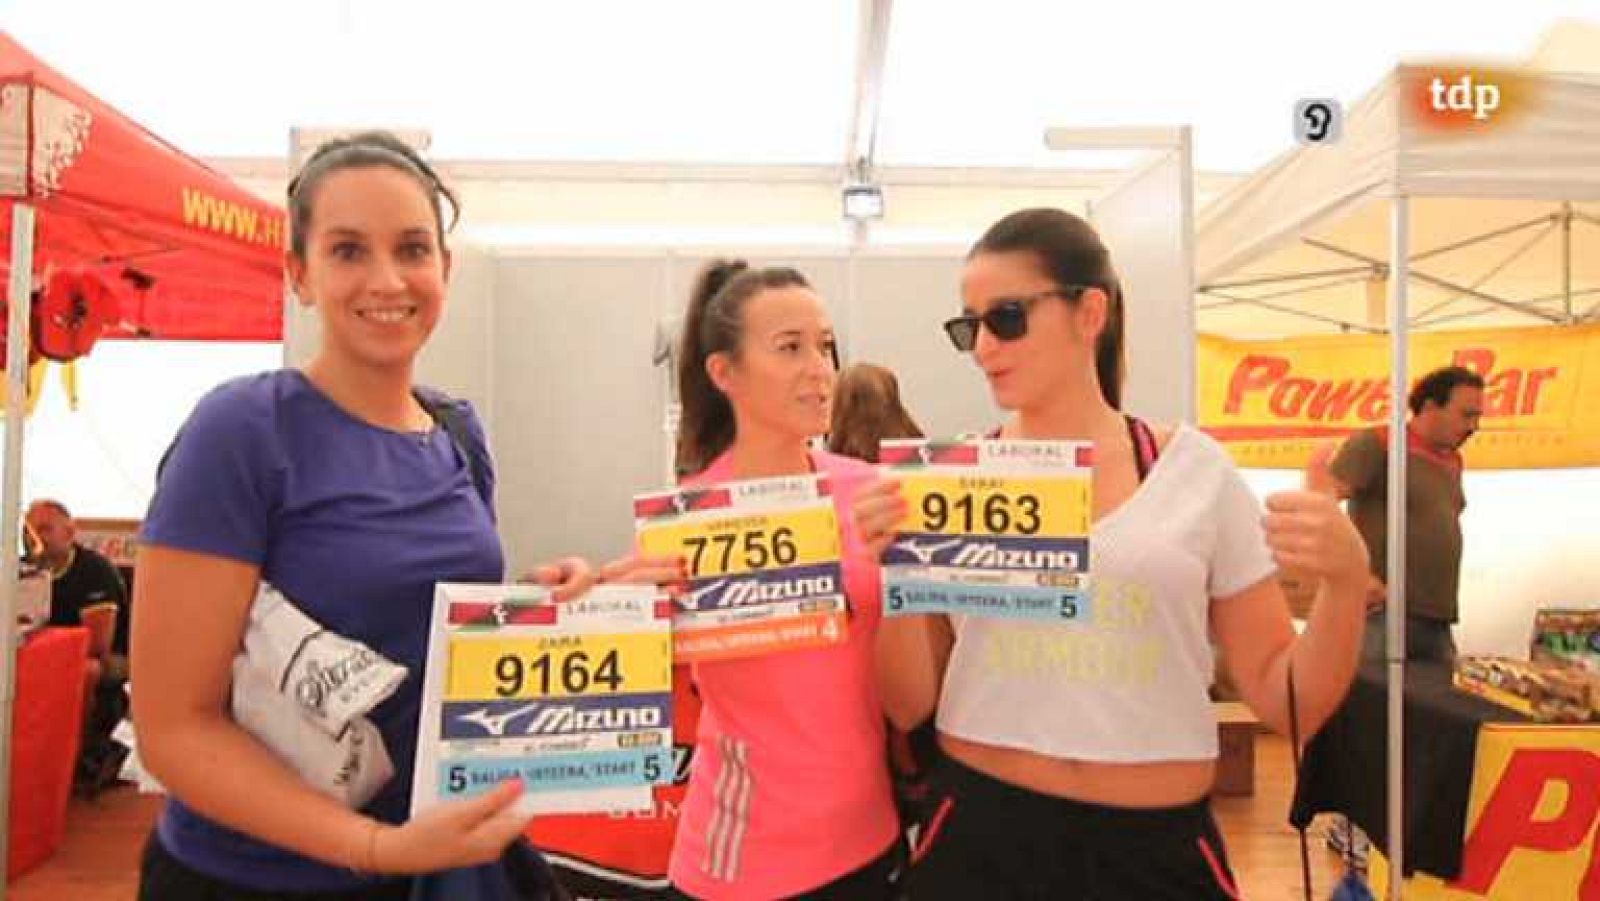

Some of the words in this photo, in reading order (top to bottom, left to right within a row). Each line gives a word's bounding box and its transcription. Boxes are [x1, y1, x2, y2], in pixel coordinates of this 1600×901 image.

[922, 491, 1041, 535] 9163
[682, 526, 798, 577] 7756
[888, 585, 904, 611] 5
[1060, 595, 1078, 619] 5
[822, 615, 841, 640] 4
[494, 648, 625, 698] 9164
[448, 765, 467, 793] 5
[642, 754, 662, 782] 5
